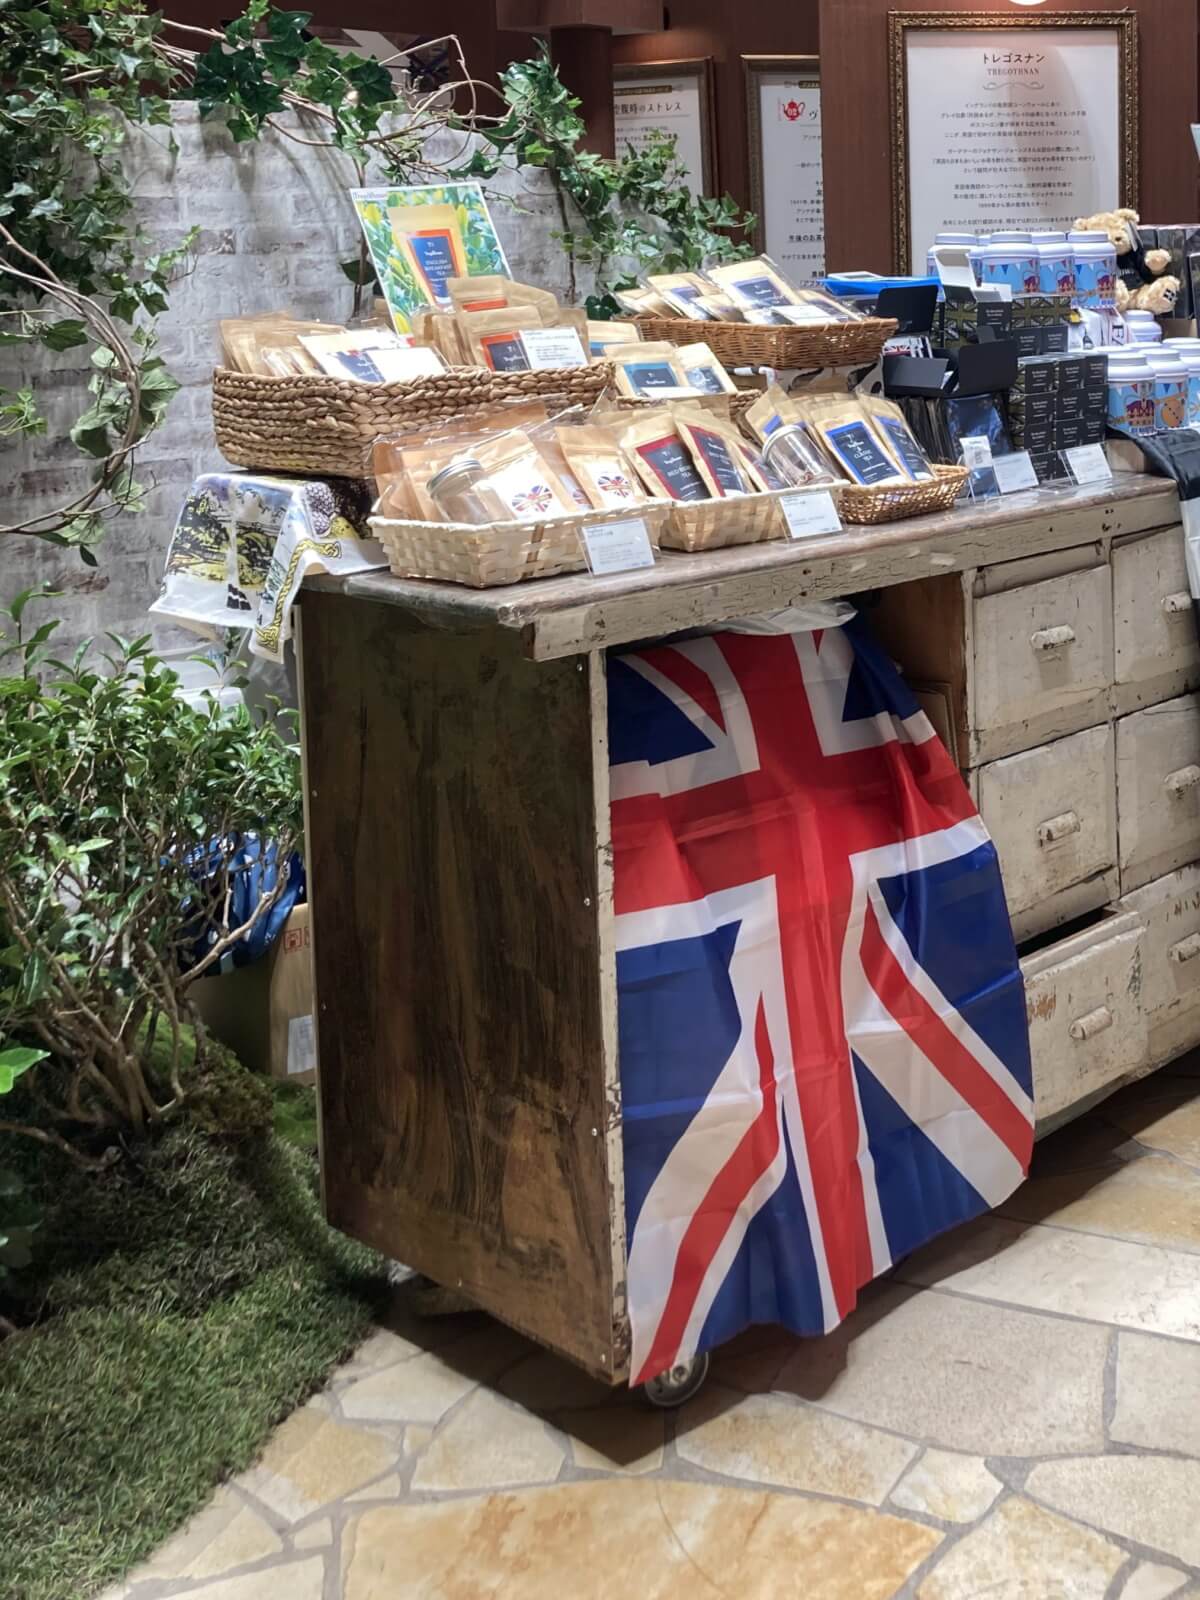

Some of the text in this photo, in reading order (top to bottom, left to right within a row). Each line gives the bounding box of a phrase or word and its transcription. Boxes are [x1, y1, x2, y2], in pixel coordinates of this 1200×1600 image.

[983, 53, 1045, 64] トレゴスナン
